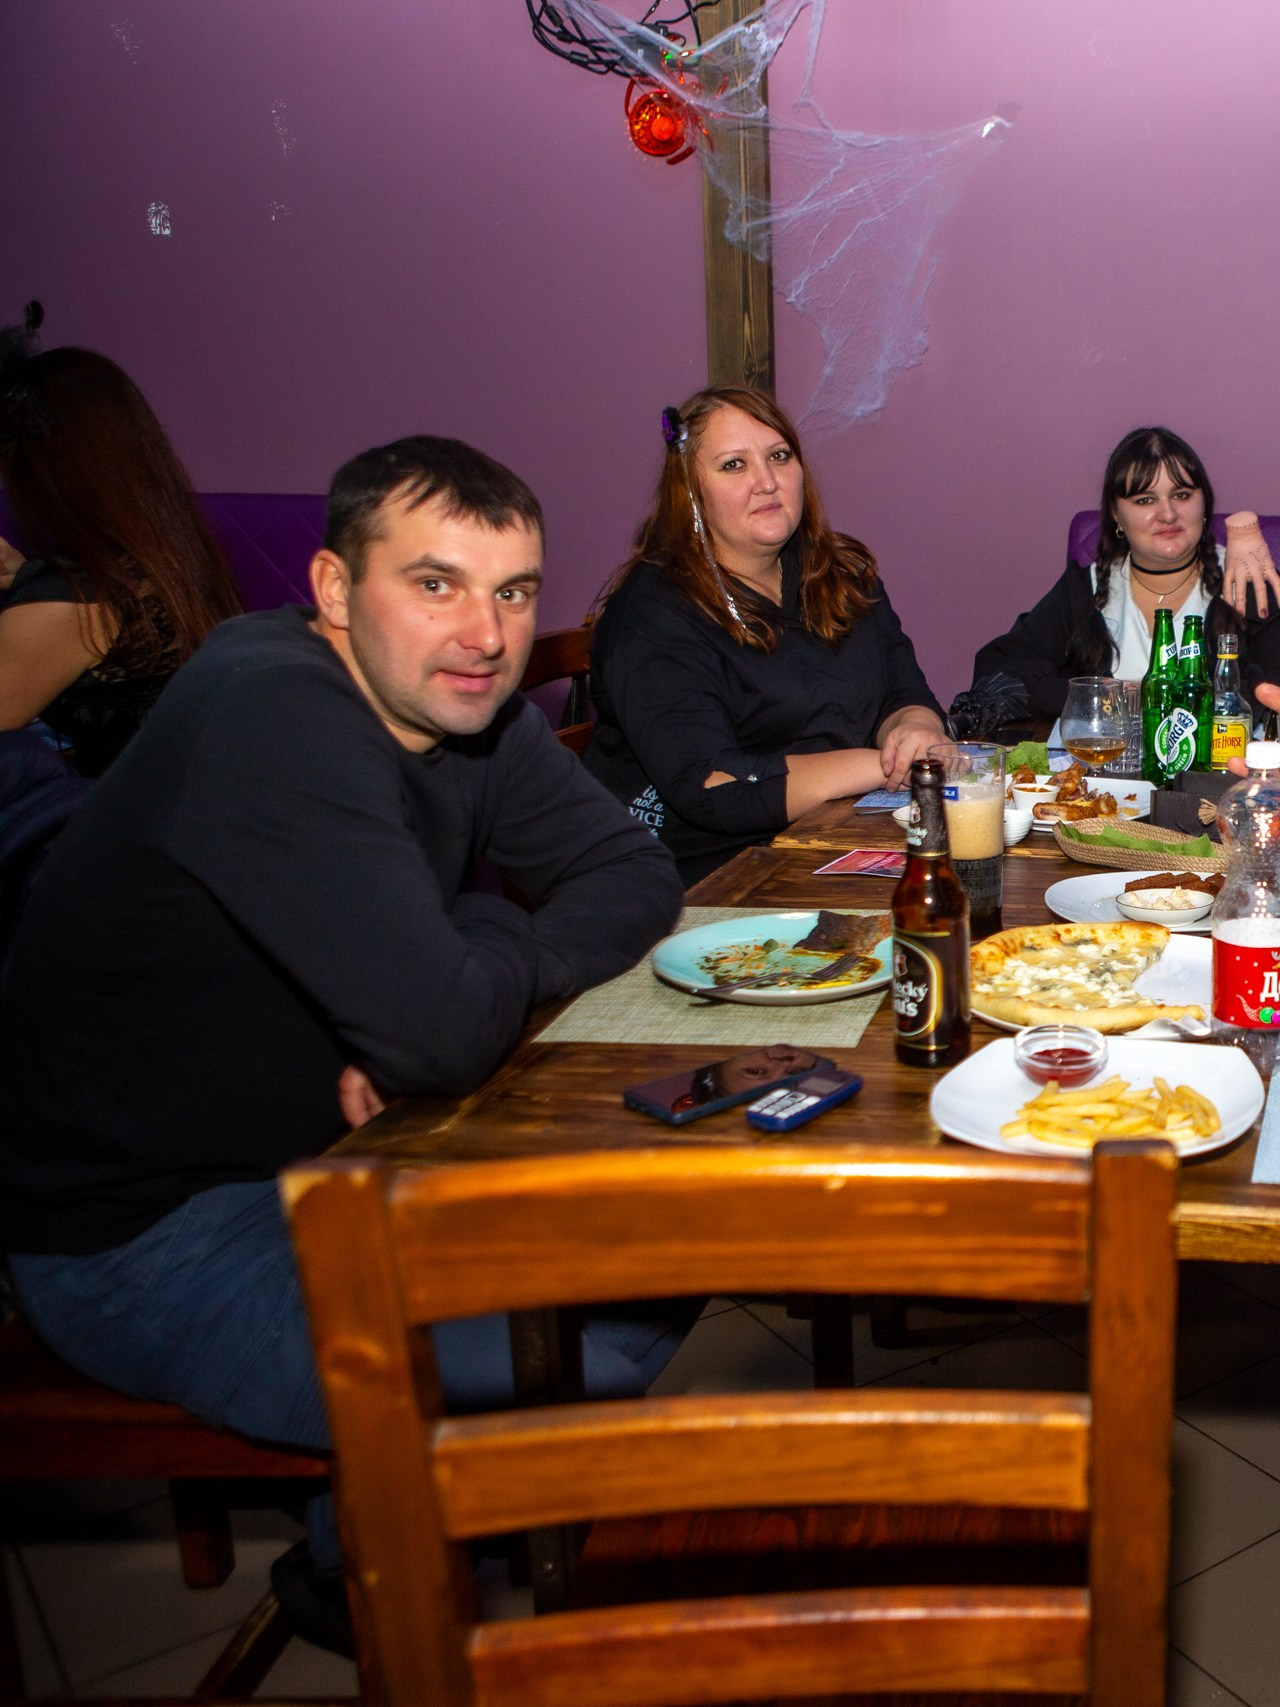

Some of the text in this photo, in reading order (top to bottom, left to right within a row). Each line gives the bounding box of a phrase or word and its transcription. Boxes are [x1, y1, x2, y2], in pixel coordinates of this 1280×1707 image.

[1212, 736, 1242, 750] ITE HORSE
[643, 785, 658, 800] is
[633, 797, 663, 812] not a
[629, 807, 664, 827] VICE
